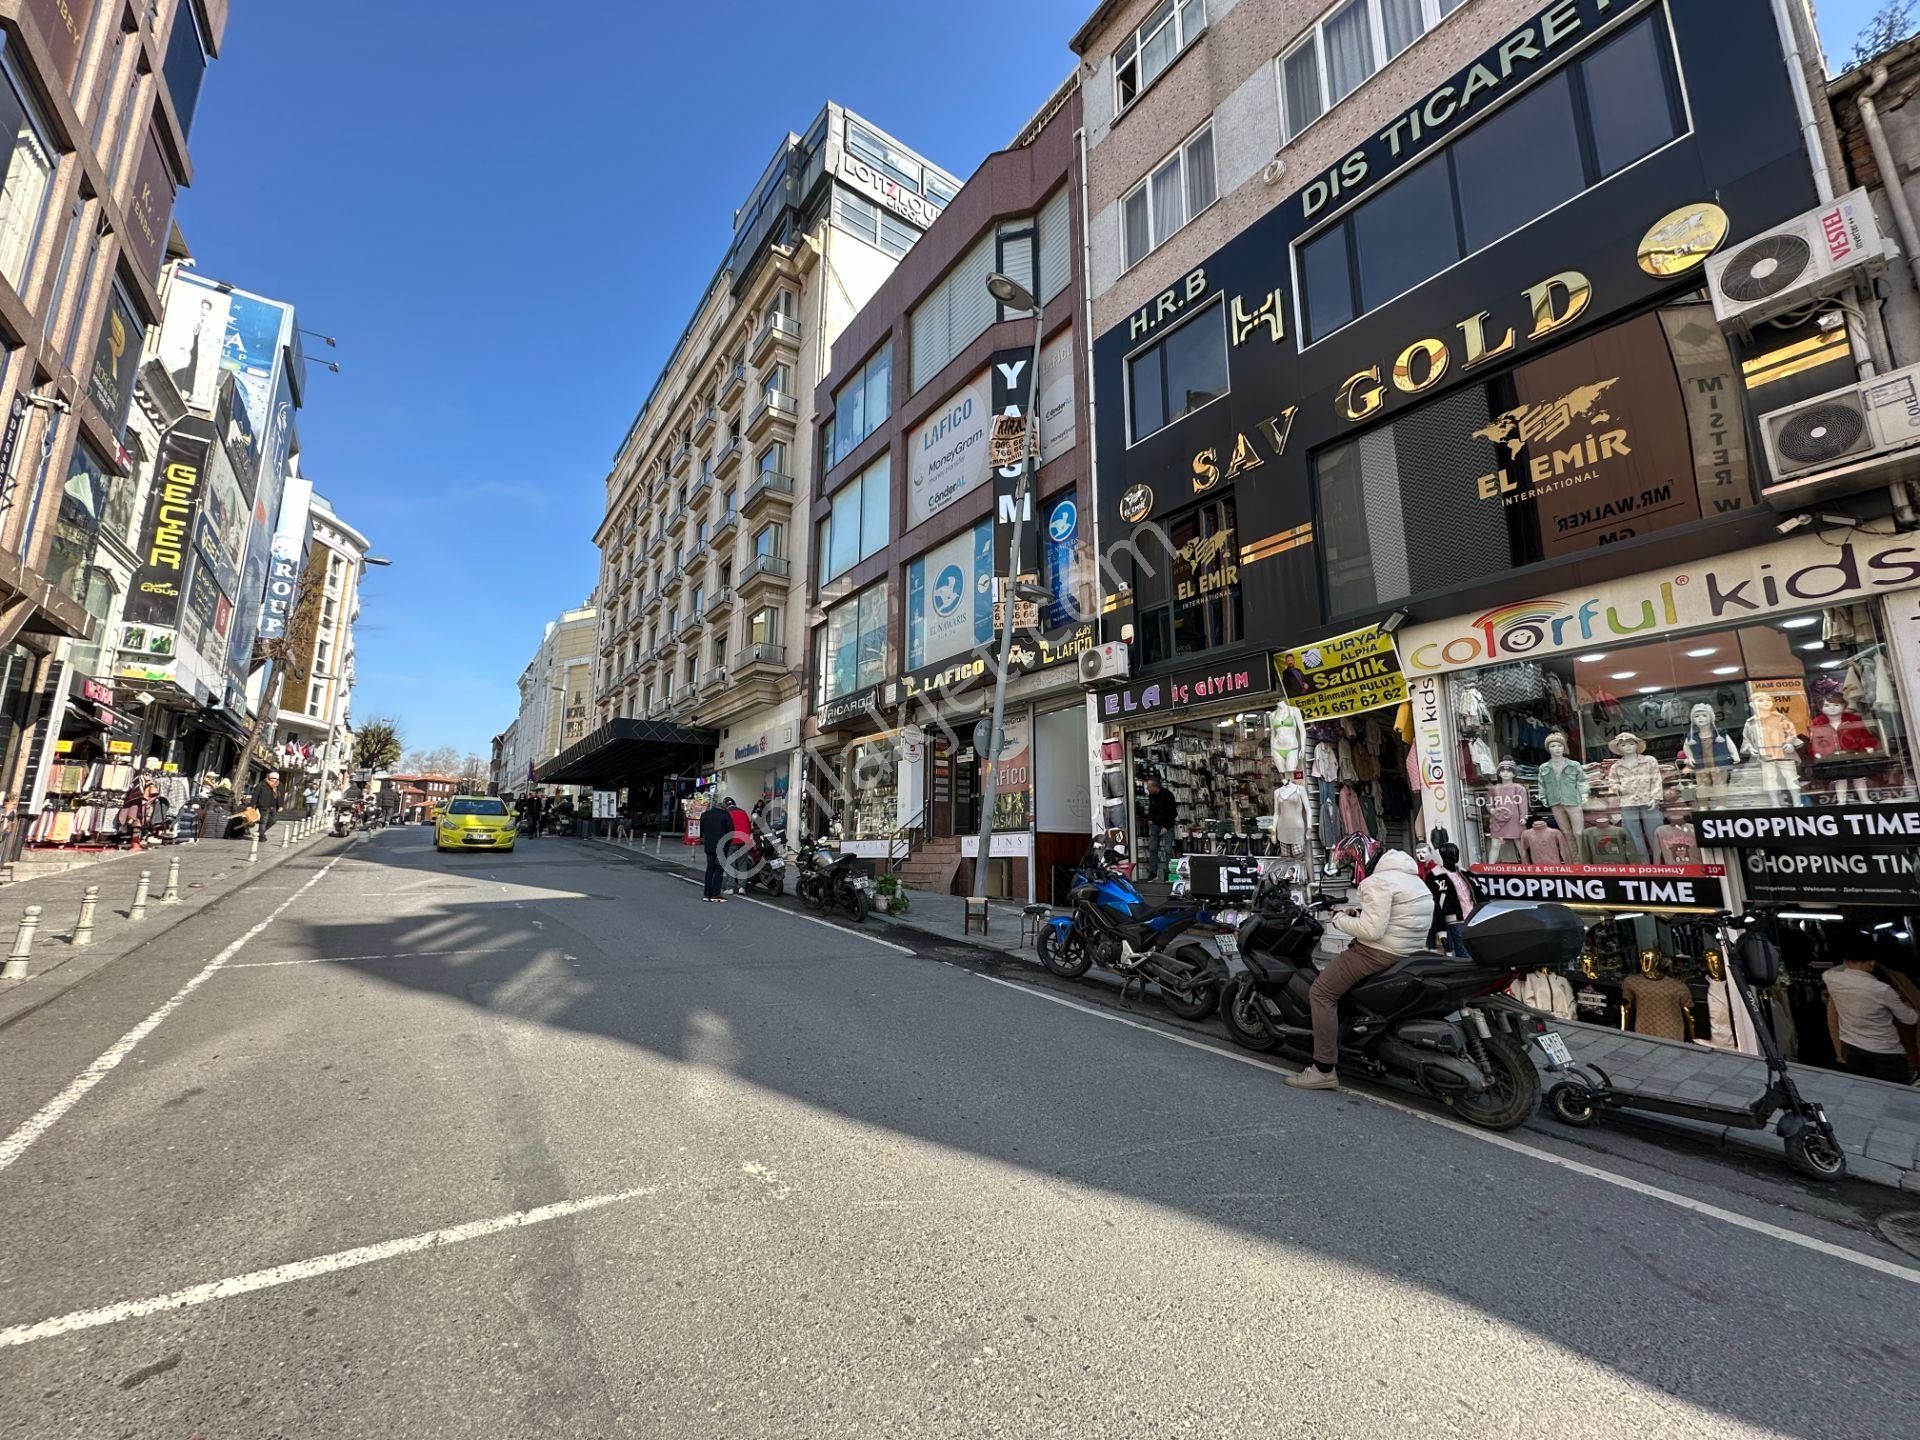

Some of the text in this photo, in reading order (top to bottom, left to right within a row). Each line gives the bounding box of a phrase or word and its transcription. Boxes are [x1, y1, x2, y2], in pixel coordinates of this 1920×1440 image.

[1379, 0, 1614, 158] TICARE
[1822, 207, 1851, 262] VESTEL
[1129, 267, 1207, 341] H.R.B
[1192, 270, 1593, 494] SAV GOLD
[928, 428, 983, 475] MoneyGram
[1476, 428, 1632, 501] EL EMİR
[1501, 470, 1601, 507] INTERNATIONAL
[1177, 565, 1239, 601] EL EMİR
[1705, 543, 1920, 617] kids
[1182, 591, 1233, 610] INTERNATIONAL
[1340, 643, 1378, 663] ALPHA
[1313, 656, 1389, 690] Satılık
[1104, 684, 1161, 715] ELA
[1295, 695, 1316, 708] Enes
[1318, 686, 1358, 703] Binmalik
[1331, 699, 1355, 714] 667
[1360, 692, 1380, 707] 62
[1382, 687, 1401, 701] 62
[1702, 812, 1920, 839] SHOPPING TIME
[1483, 865, 1533, 873] WHOLESALE
[1583, 865, 1616, 874] Оптом
[1638, 866, 1686, 876] розницу
[1478, 876, 1696, 903] SHOPPING TIME
